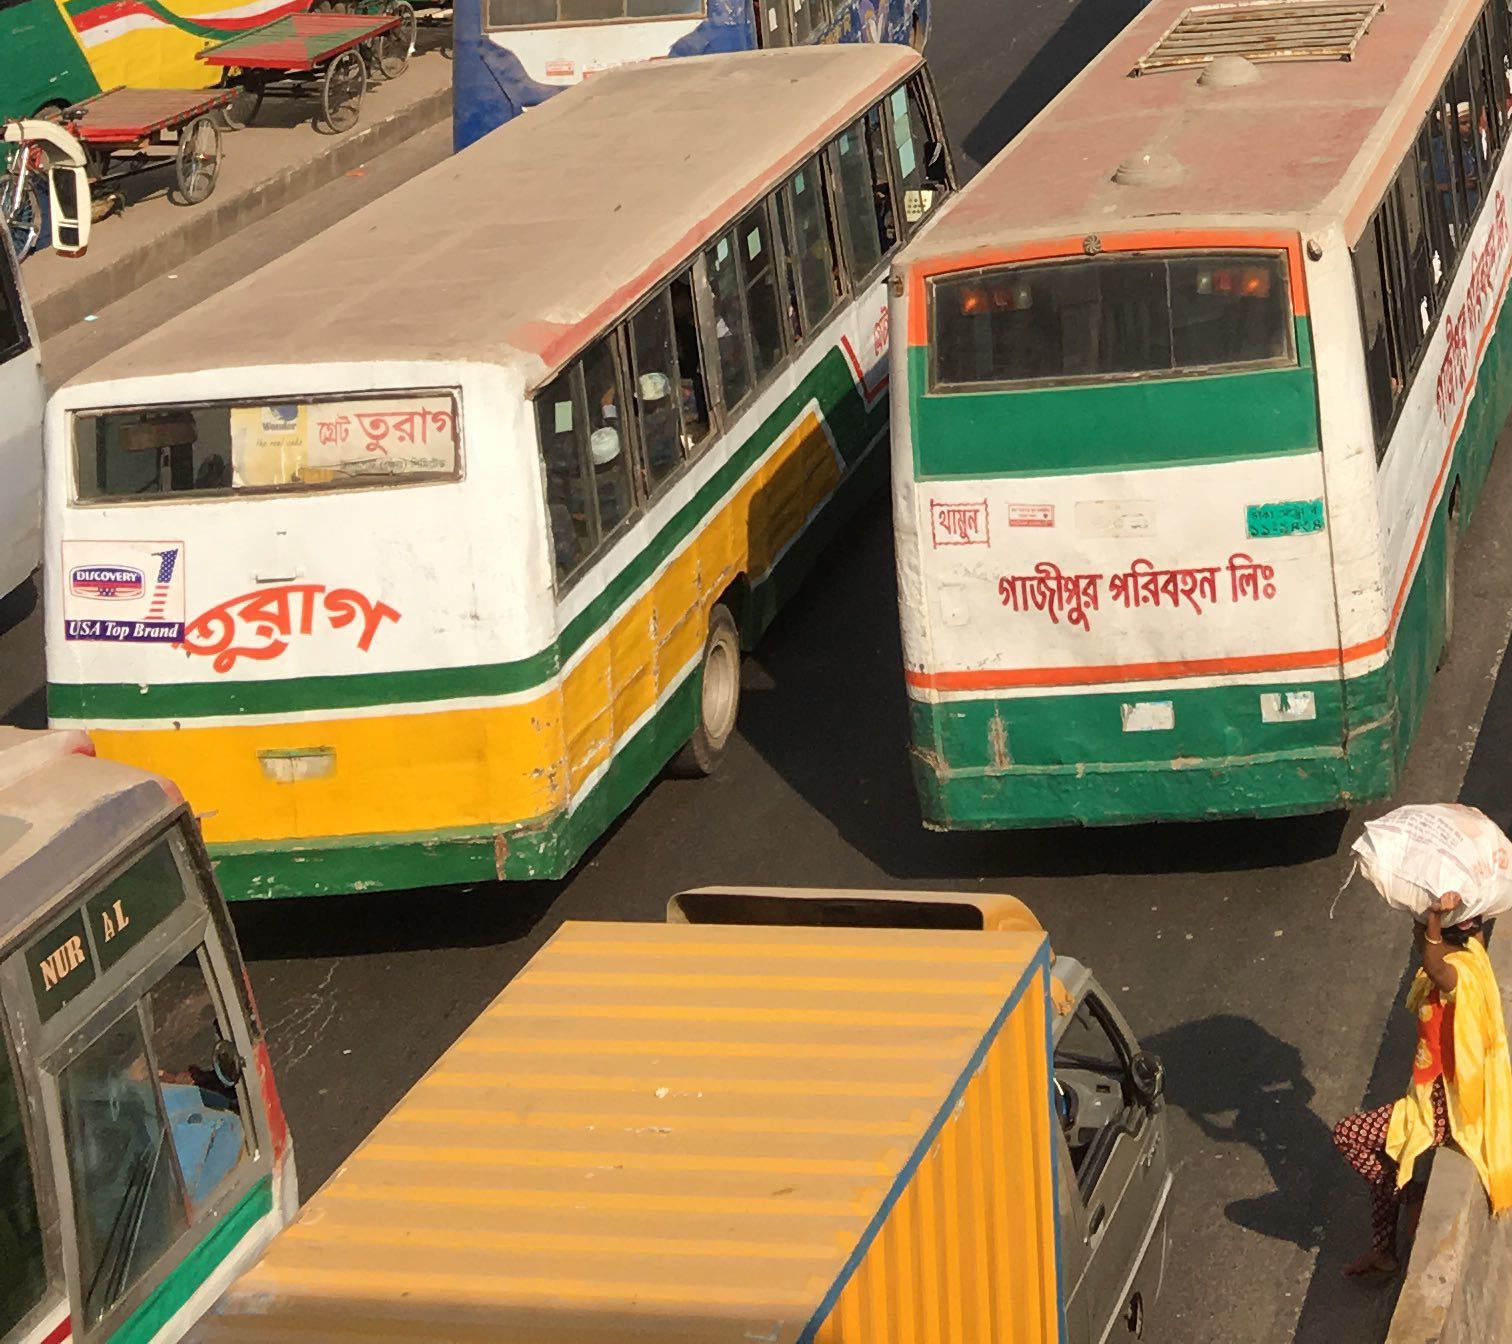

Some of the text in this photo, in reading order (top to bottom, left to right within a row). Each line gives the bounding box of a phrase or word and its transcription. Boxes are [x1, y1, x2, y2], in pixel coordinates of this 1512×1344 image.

[354, 406, 454, 455] তুরাগ
[937, 507, 981, 544] থামুন
[76, 569, 139, 583] DISCOVERY
[999, 552, 1277, 632] গাজীপুর পরিবহন লিঃ
[68, 619, 179, 641] USA Top Brand
[171, 583, 402, 674] তুরাগ
[39, 898, 130, 992] NUR AL
